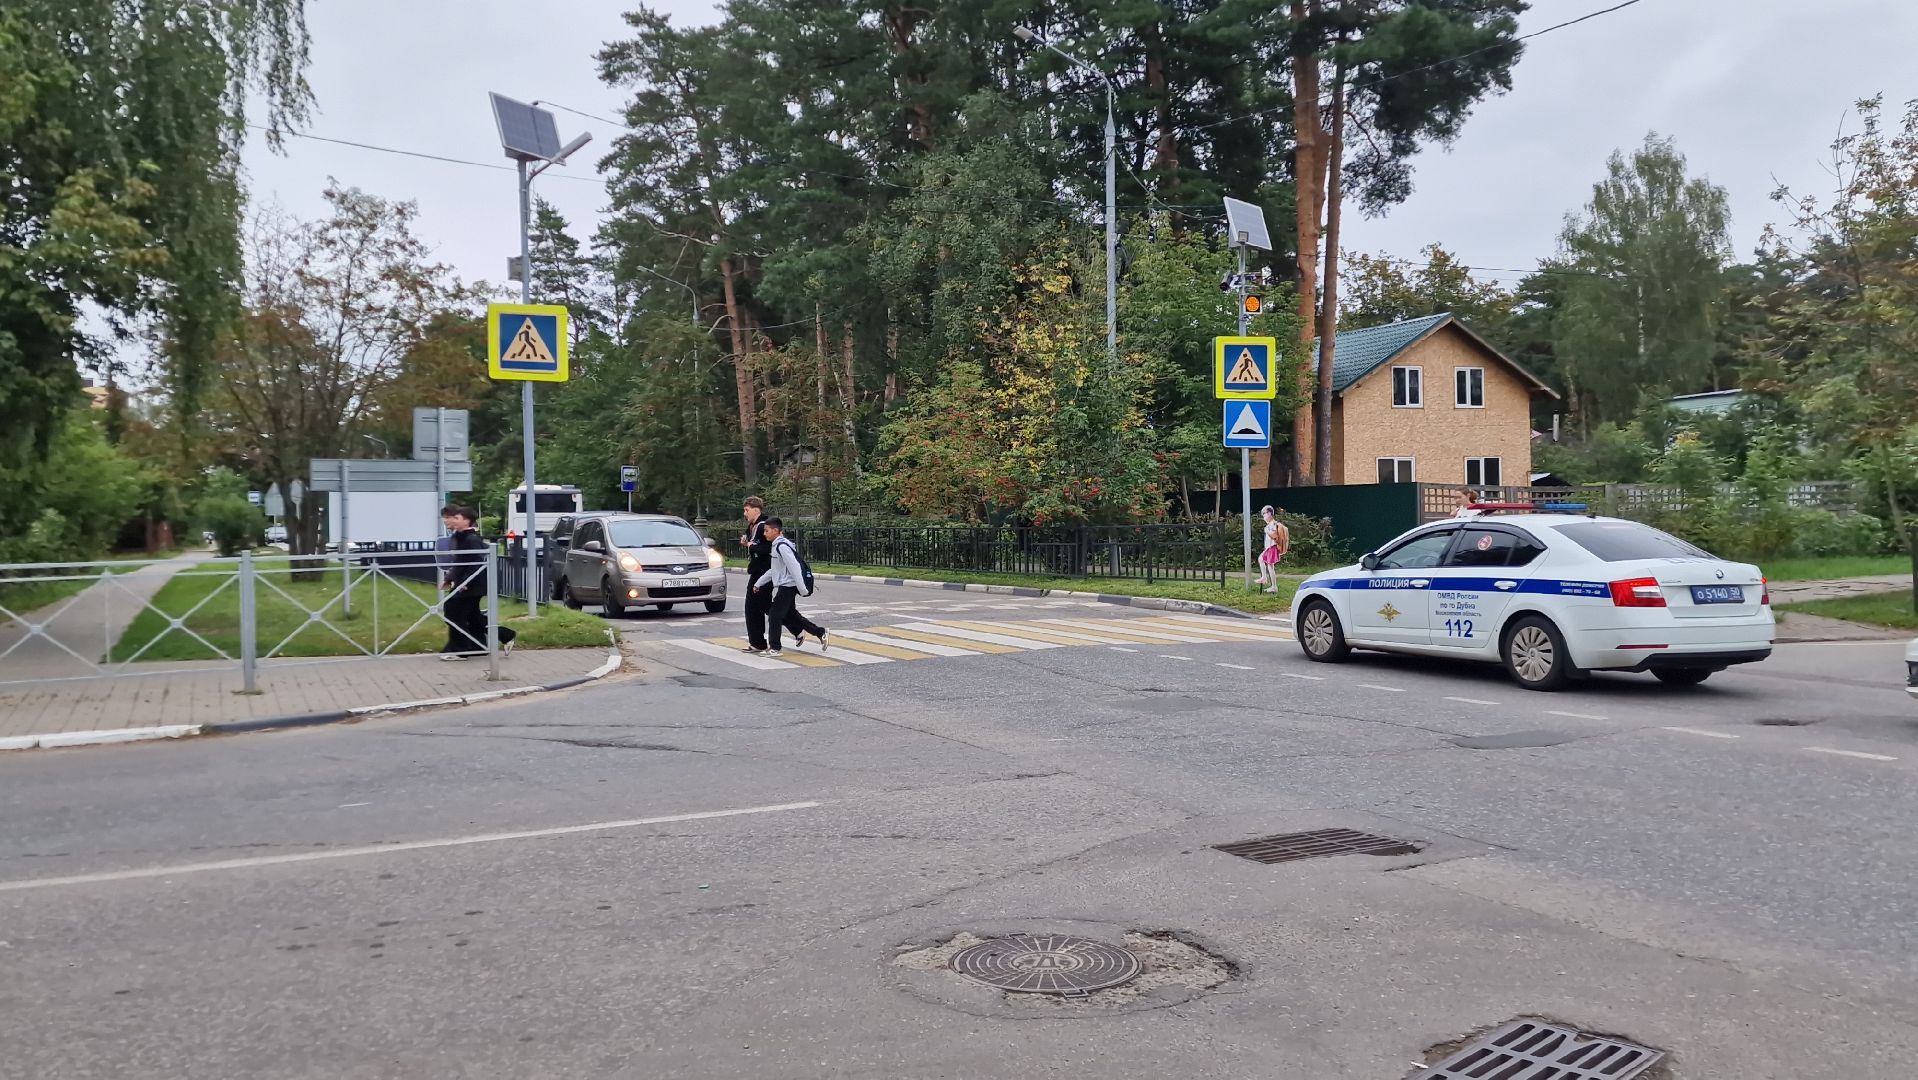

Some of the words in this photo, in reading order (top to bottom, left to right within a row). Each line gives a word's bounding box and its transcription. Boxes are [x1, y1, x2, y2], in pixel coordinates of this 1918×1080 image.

[1369, 579, 1410, 589] ПОЛИЦИЯ
[1437, 592, 1455, 600] ОМВД
[1456, 601, 1476, 610] Дубна
[1445, 619, 1474, 638] 112
